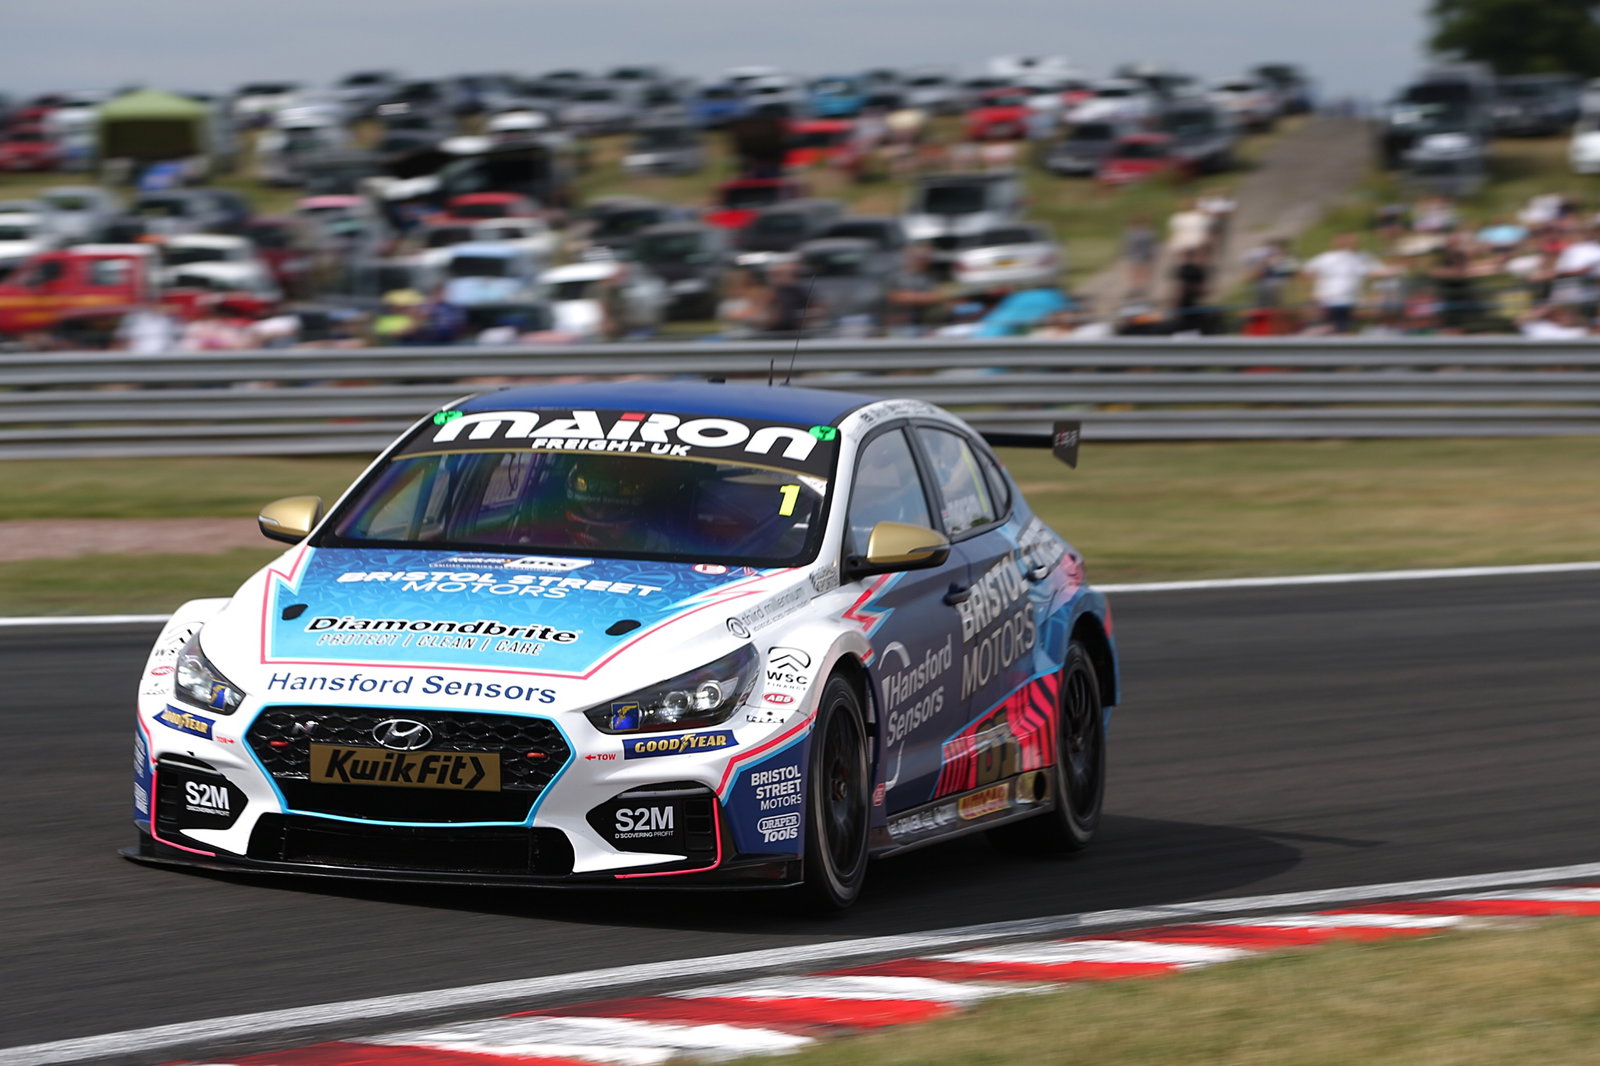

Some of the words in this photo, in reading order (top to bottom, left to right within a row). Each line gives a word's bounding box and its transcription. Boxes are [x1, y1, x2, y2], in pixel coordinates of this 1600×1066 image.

[532, 437, 645, 454] FREIGHT
[650, 441, 692, 457] UK
[778, 485, 801, 517] 1
[336, 571, 498, 585] BRISTOL
[508, 574, 662, 597] STREET
[400, 580, 571, 599] MOTORS
[957, 552, 1030, 643] BRISTOL
[308, 617, 579, 644] Diamondbrite
[317, 634, 398, 647] PROTECT
[417, 636, 474, 650] CLEAN
[496, 640, 545, 656] CARE
[961, 602, 1036, 701] MOTORS
[767, 670, 808, 685] WSC
[889, 634, 952, 708] Hansford
[267, 671, 414, 695] Hansford
[421, 675, 558, 704] Sensors
[887, 686, 944, 747] Sensors
[634, 734, 728, 754] GOODYEAR
[597, 753, 616, 761] TOW
[751, 765, 801, 787] BRISTOL
[184, 781, 230, 811] S2M
[756, 778, 802, 799] STREET
[760, 793, 802, 811] MOTORS
[615, 805, 674, 832] S2M
[761, 815, 798, 831] DRAPER
